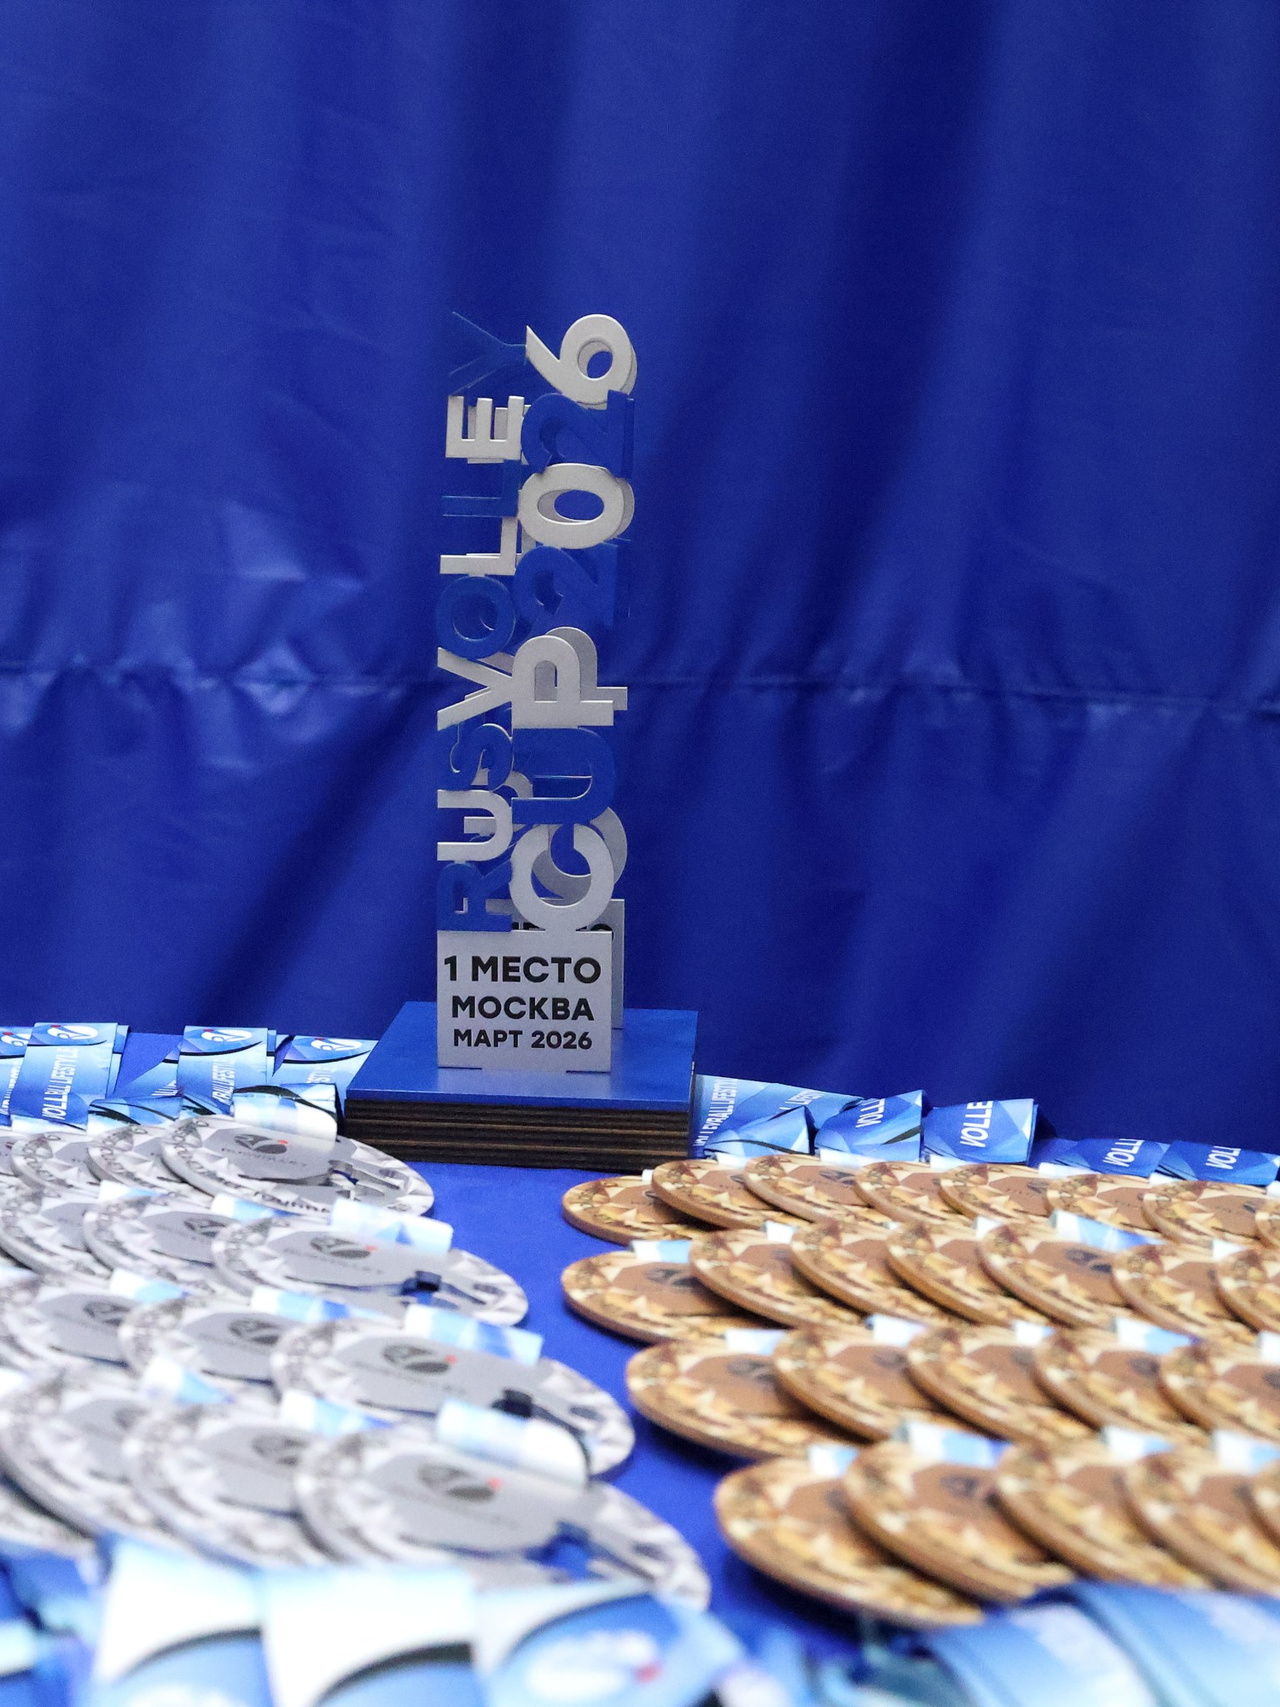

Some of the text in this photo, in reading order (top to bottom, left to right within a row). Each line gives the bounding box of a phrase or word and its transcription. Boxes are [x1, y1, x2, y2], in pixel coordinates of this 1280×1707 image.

[509, 634, 615, 928] CUP
[443, 955, 602, 983] 1 МЕСТО
[451, 994, 595, 1022] МОСКВА
[452, 1028, 593, 1050] МАРТ 2026
